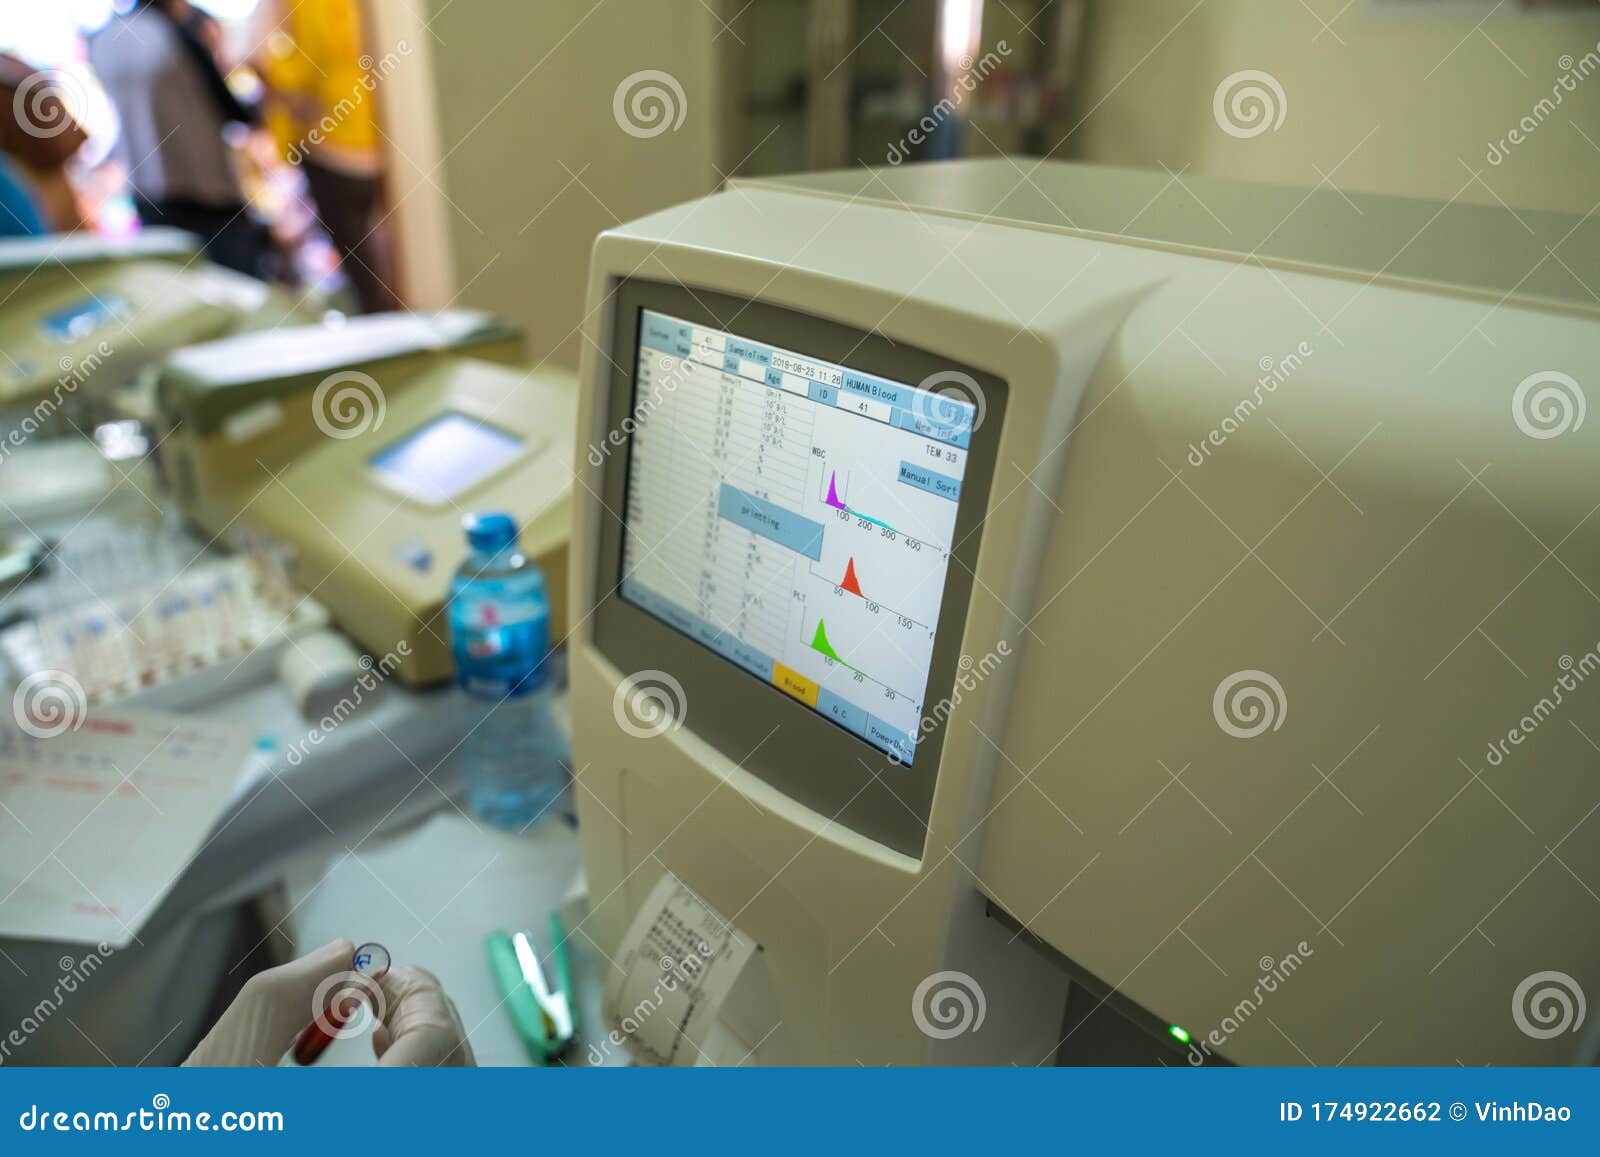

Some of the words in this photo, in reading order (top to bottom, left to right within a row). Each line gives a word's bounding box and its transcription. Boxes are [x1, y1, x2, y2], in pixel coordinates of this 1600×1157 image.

[846, 378, 871, 394] HUMAN
[872, 386, 897, 402] Blood
[858, 401, 869, 412] 41
[926, 444, 942, 458] TEM
[945, 451, 957, 463] 33
[901, 467, 931, 486] Manual
[935, 477, 958, 496] Sort
[835, 509, 850, 522] 100
[857, 518, 873, 531] 200
[880, 528, 896, 541] 300
[905, 538, 921, 552] 400
[833, 586, 844, 597] 50
[865, 601, 880, 614] 100
[898, 616, 913, 630] 150
[853, 671, 864, 683] 20
[884, 688, 896, 701] 30
